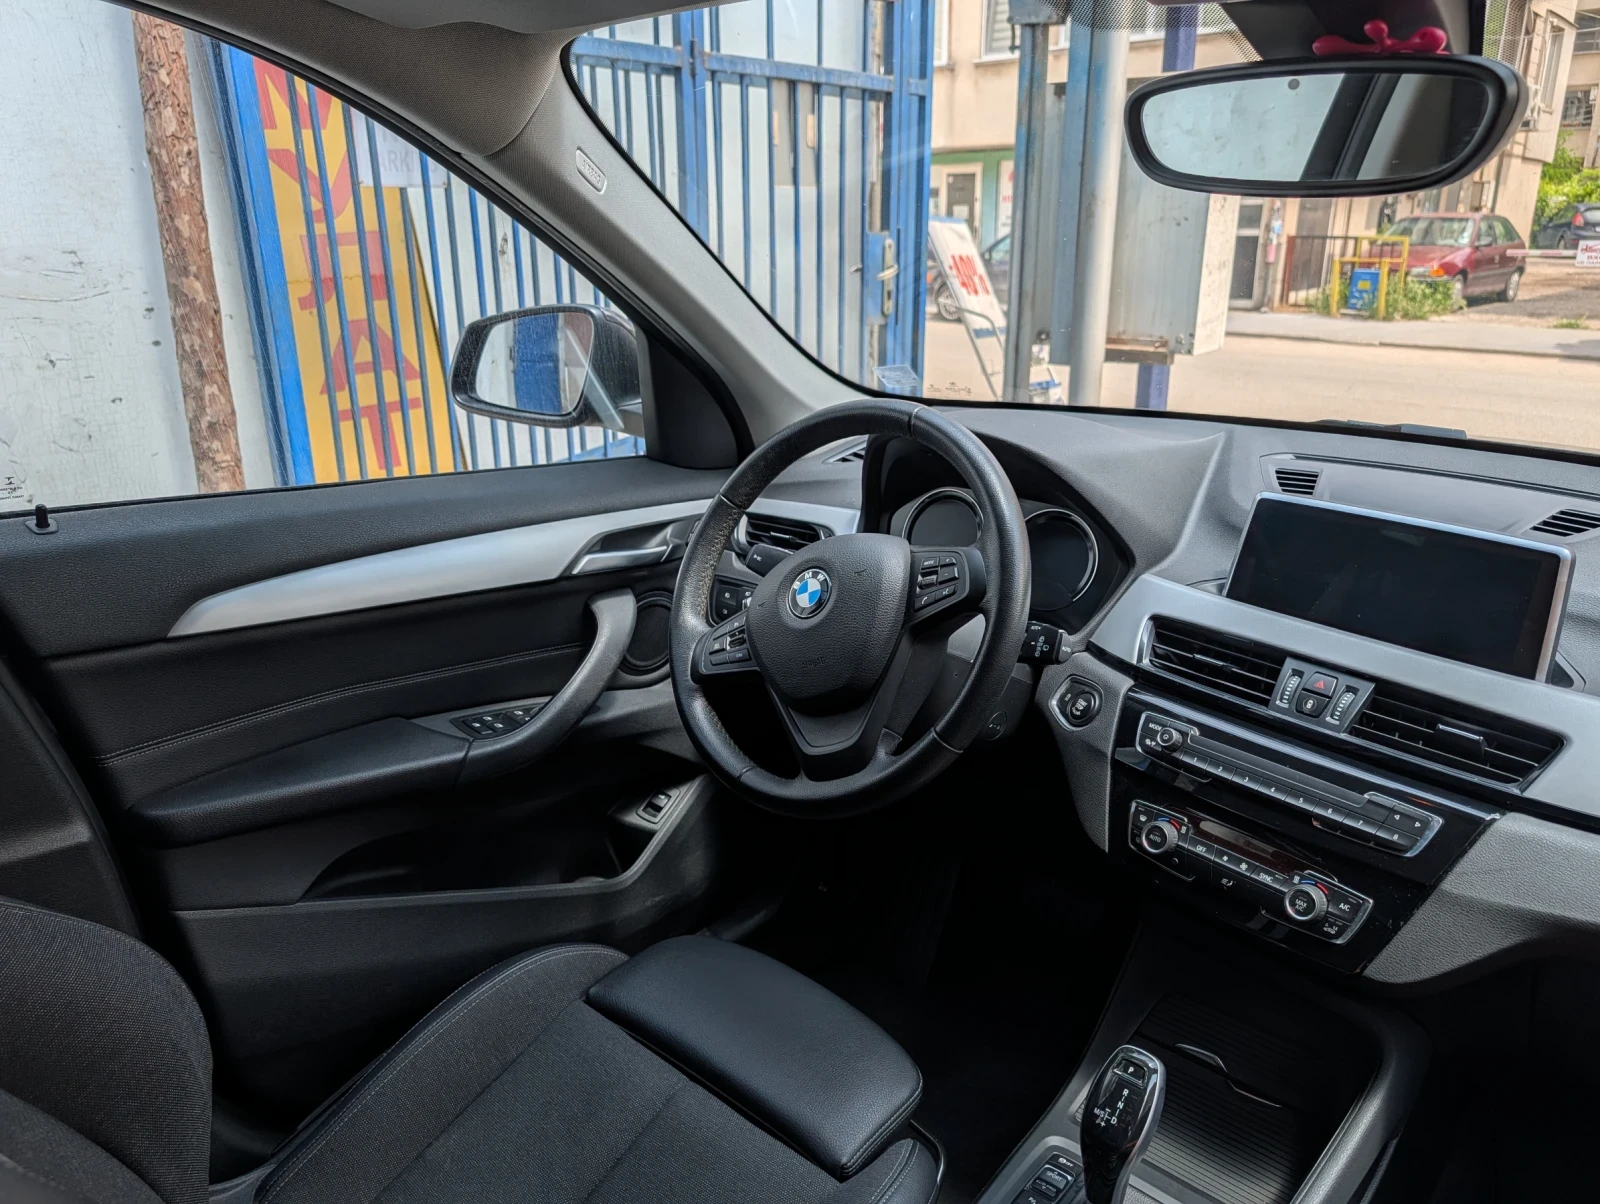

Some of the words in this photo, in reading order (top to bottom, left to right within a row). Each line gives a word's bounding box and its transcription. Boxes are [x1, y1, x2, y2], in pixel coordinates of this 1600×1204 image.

[793, 571, 826, 589] BMW
[1148, 834, 1162, 843] AUTO
[1196, 844, 1207, 853] OFF
[1259, 872, 1274, 883] SYNC
[1295, 898, 1308, 908] MAX
[1339, 902, 1351, 912] A/C
[1295, 904, 1304, 912] A/C
[1127, 1066, 1135, 1074] P
[1122, 1088, 1129, 1097] R
[1117, 1101, 1124, 1109] N
[1110, 1116, 1117, 1125] D
[1046, 1170, 1062, 1181] SPORT
[1046, 1184, 1057, 1192] PRO
